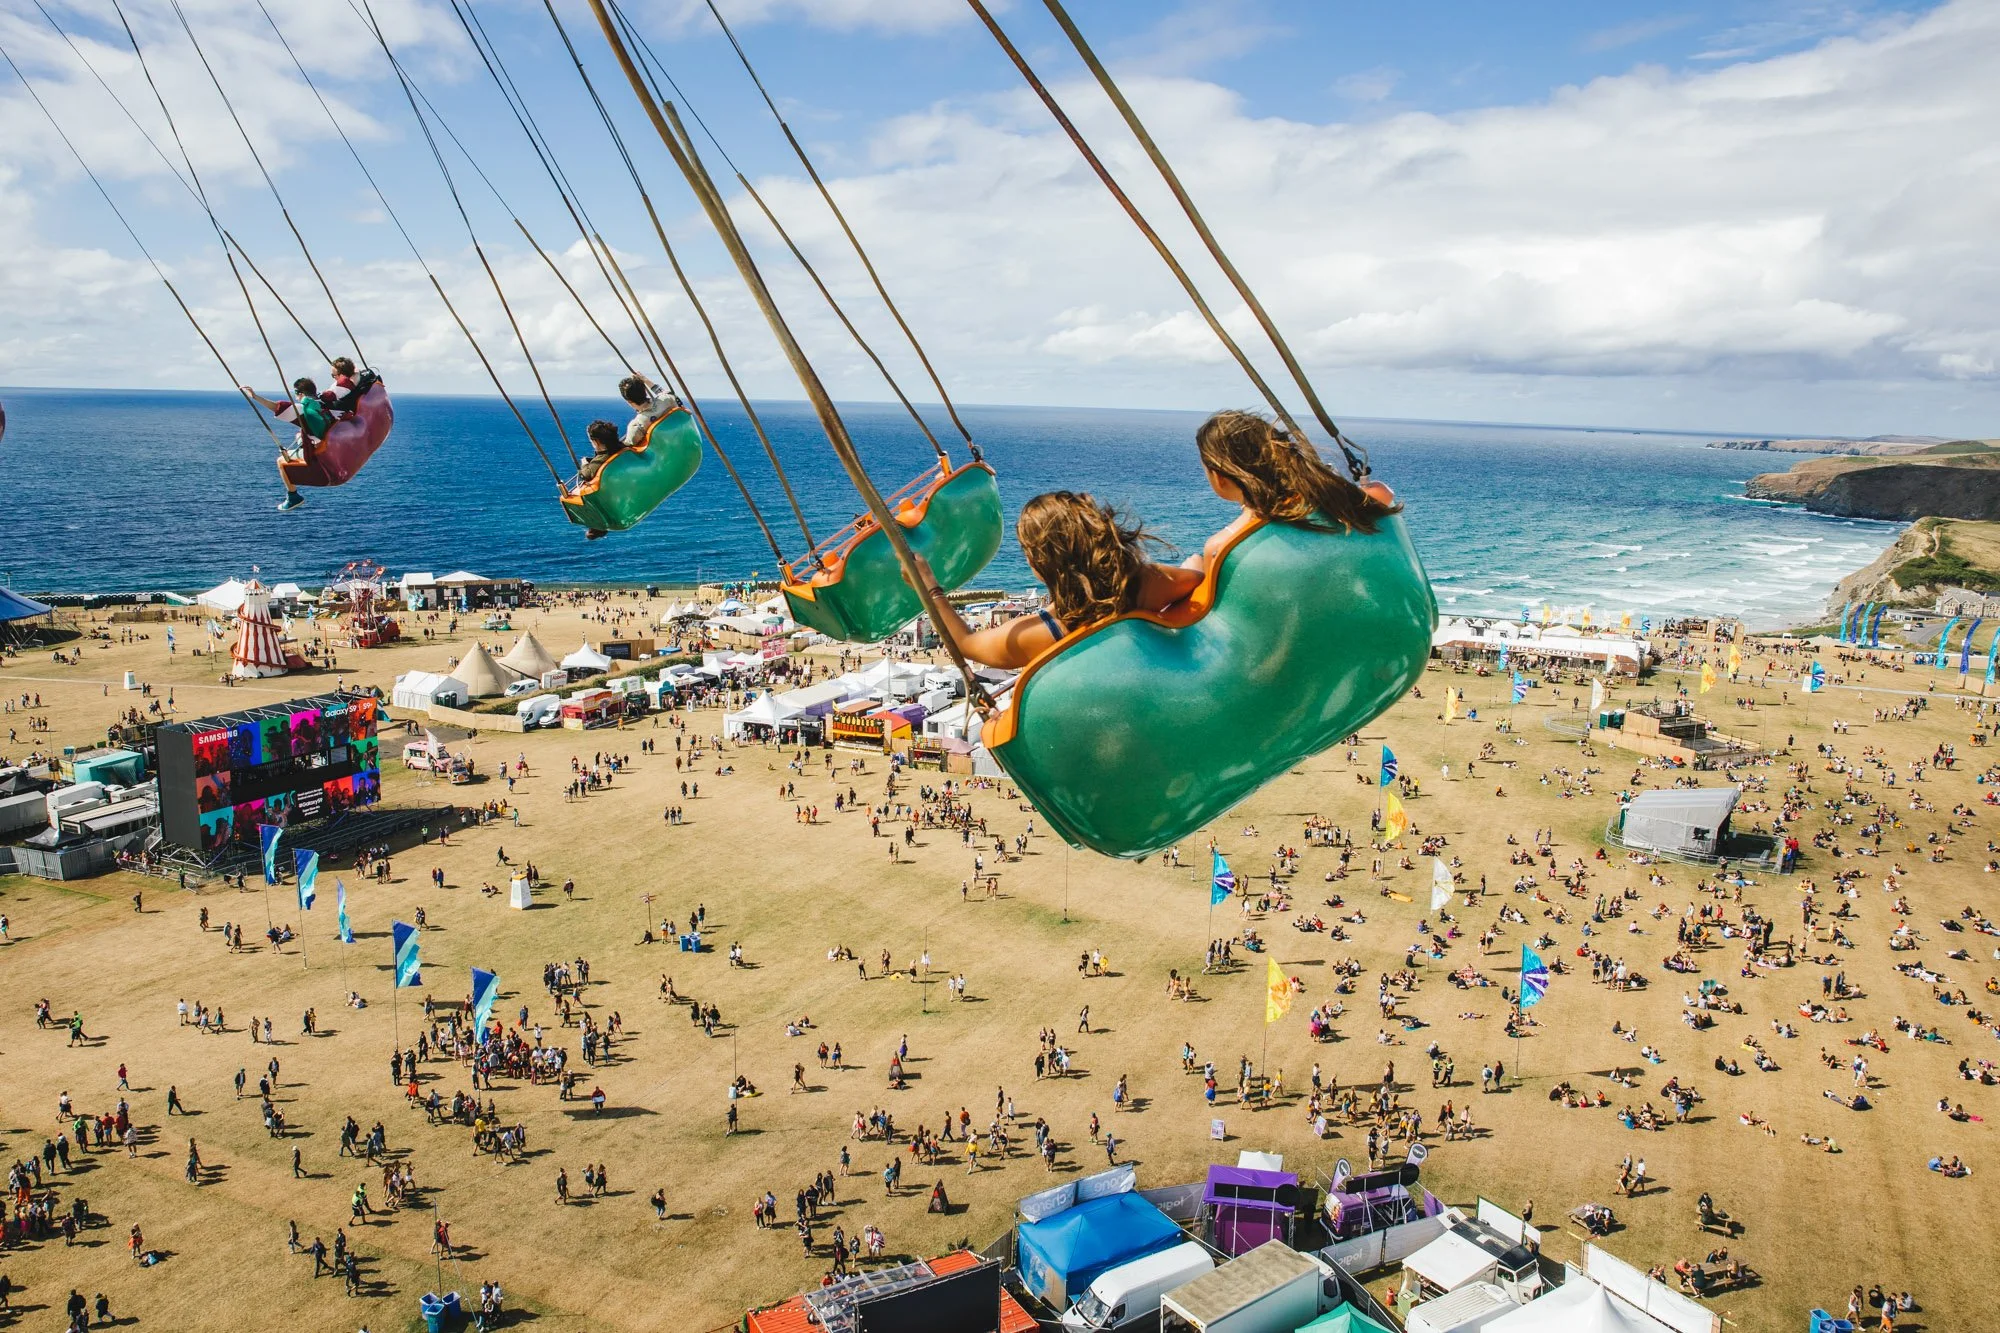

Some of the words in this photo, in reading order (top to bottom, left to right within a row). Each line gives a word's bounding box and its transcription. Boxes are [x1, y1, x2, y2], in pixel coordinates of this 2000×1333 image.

[1484, 643, 1528, 652] CORISH
[325, 708, 348, 718] Galaxy
[198, 730, 238, 744] SAMSUNG
